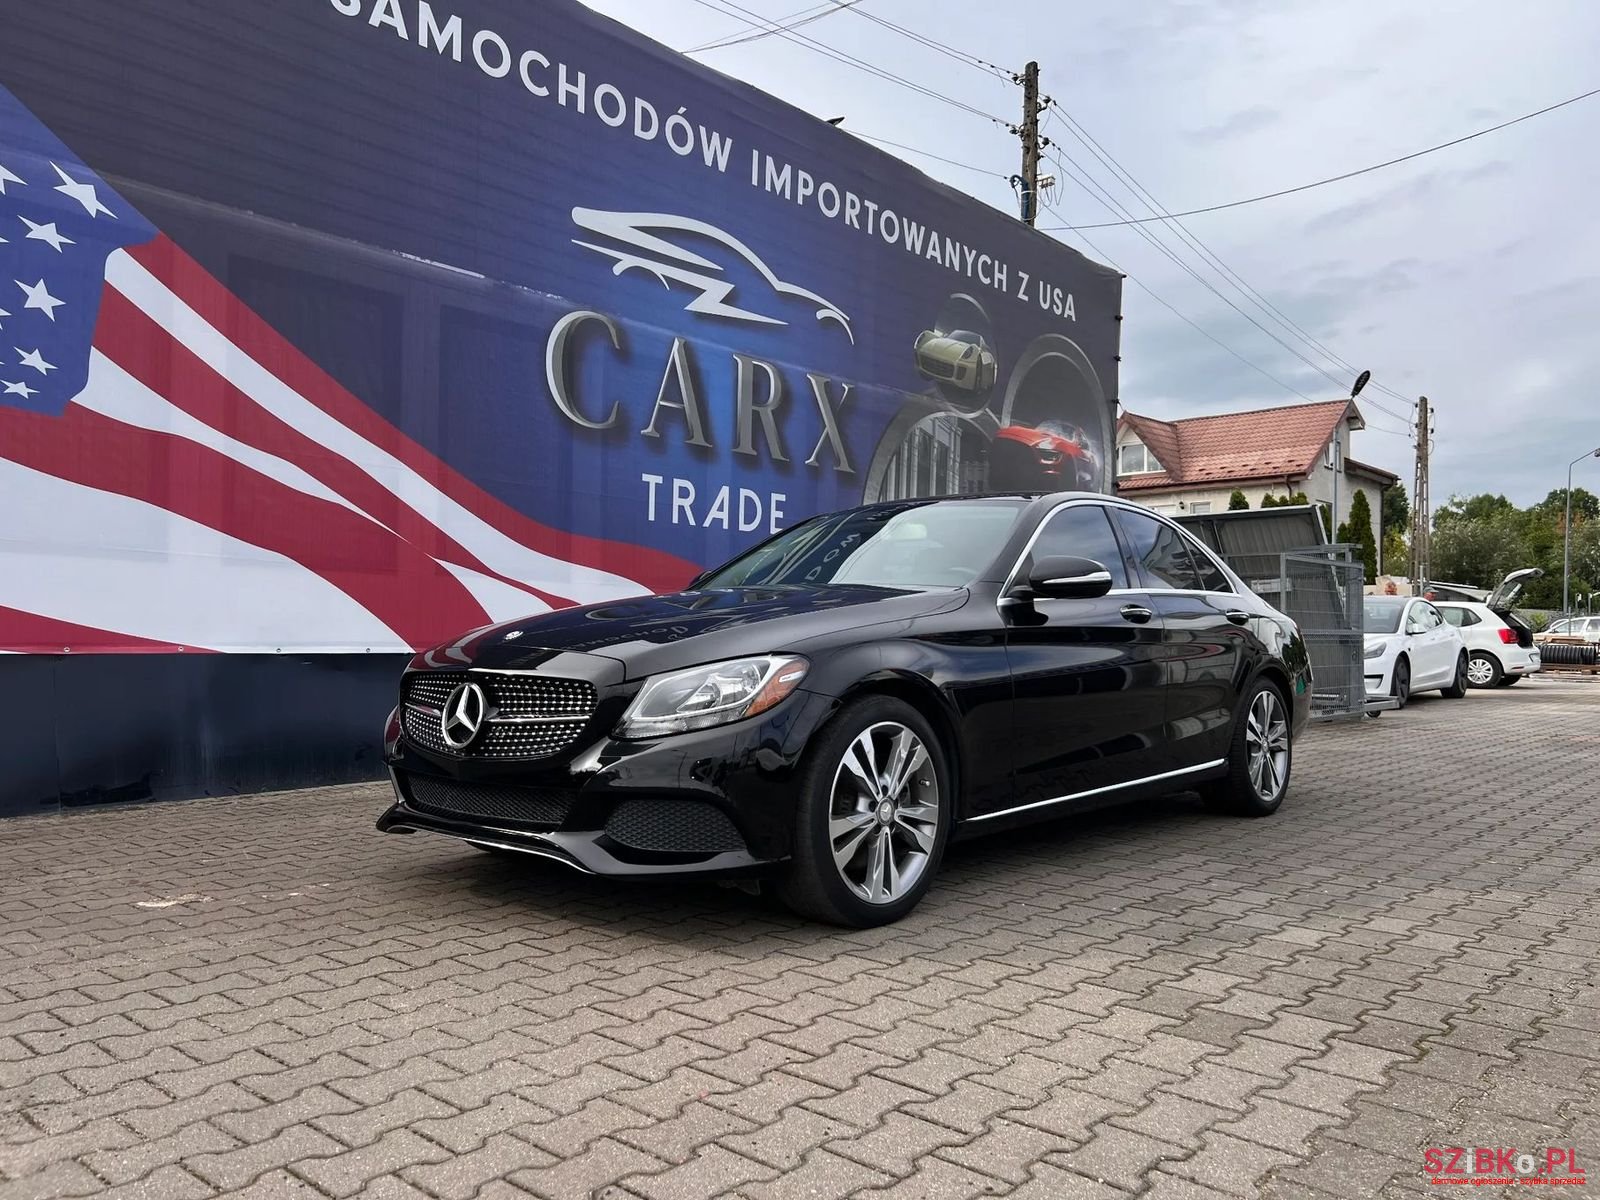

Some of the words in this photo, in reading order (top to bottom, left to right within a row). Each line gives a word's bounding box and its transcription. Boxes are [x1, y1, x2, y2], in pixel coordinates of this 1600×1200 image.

[752, 149, 1007, 292] IMPORTOWANYCH
[1017, 271, 1030, 302] Z
[1039, 281, 1076, 322] USA
[545, 310, 856, 474] CARX
[641, 473, 786, 534] TRADE
